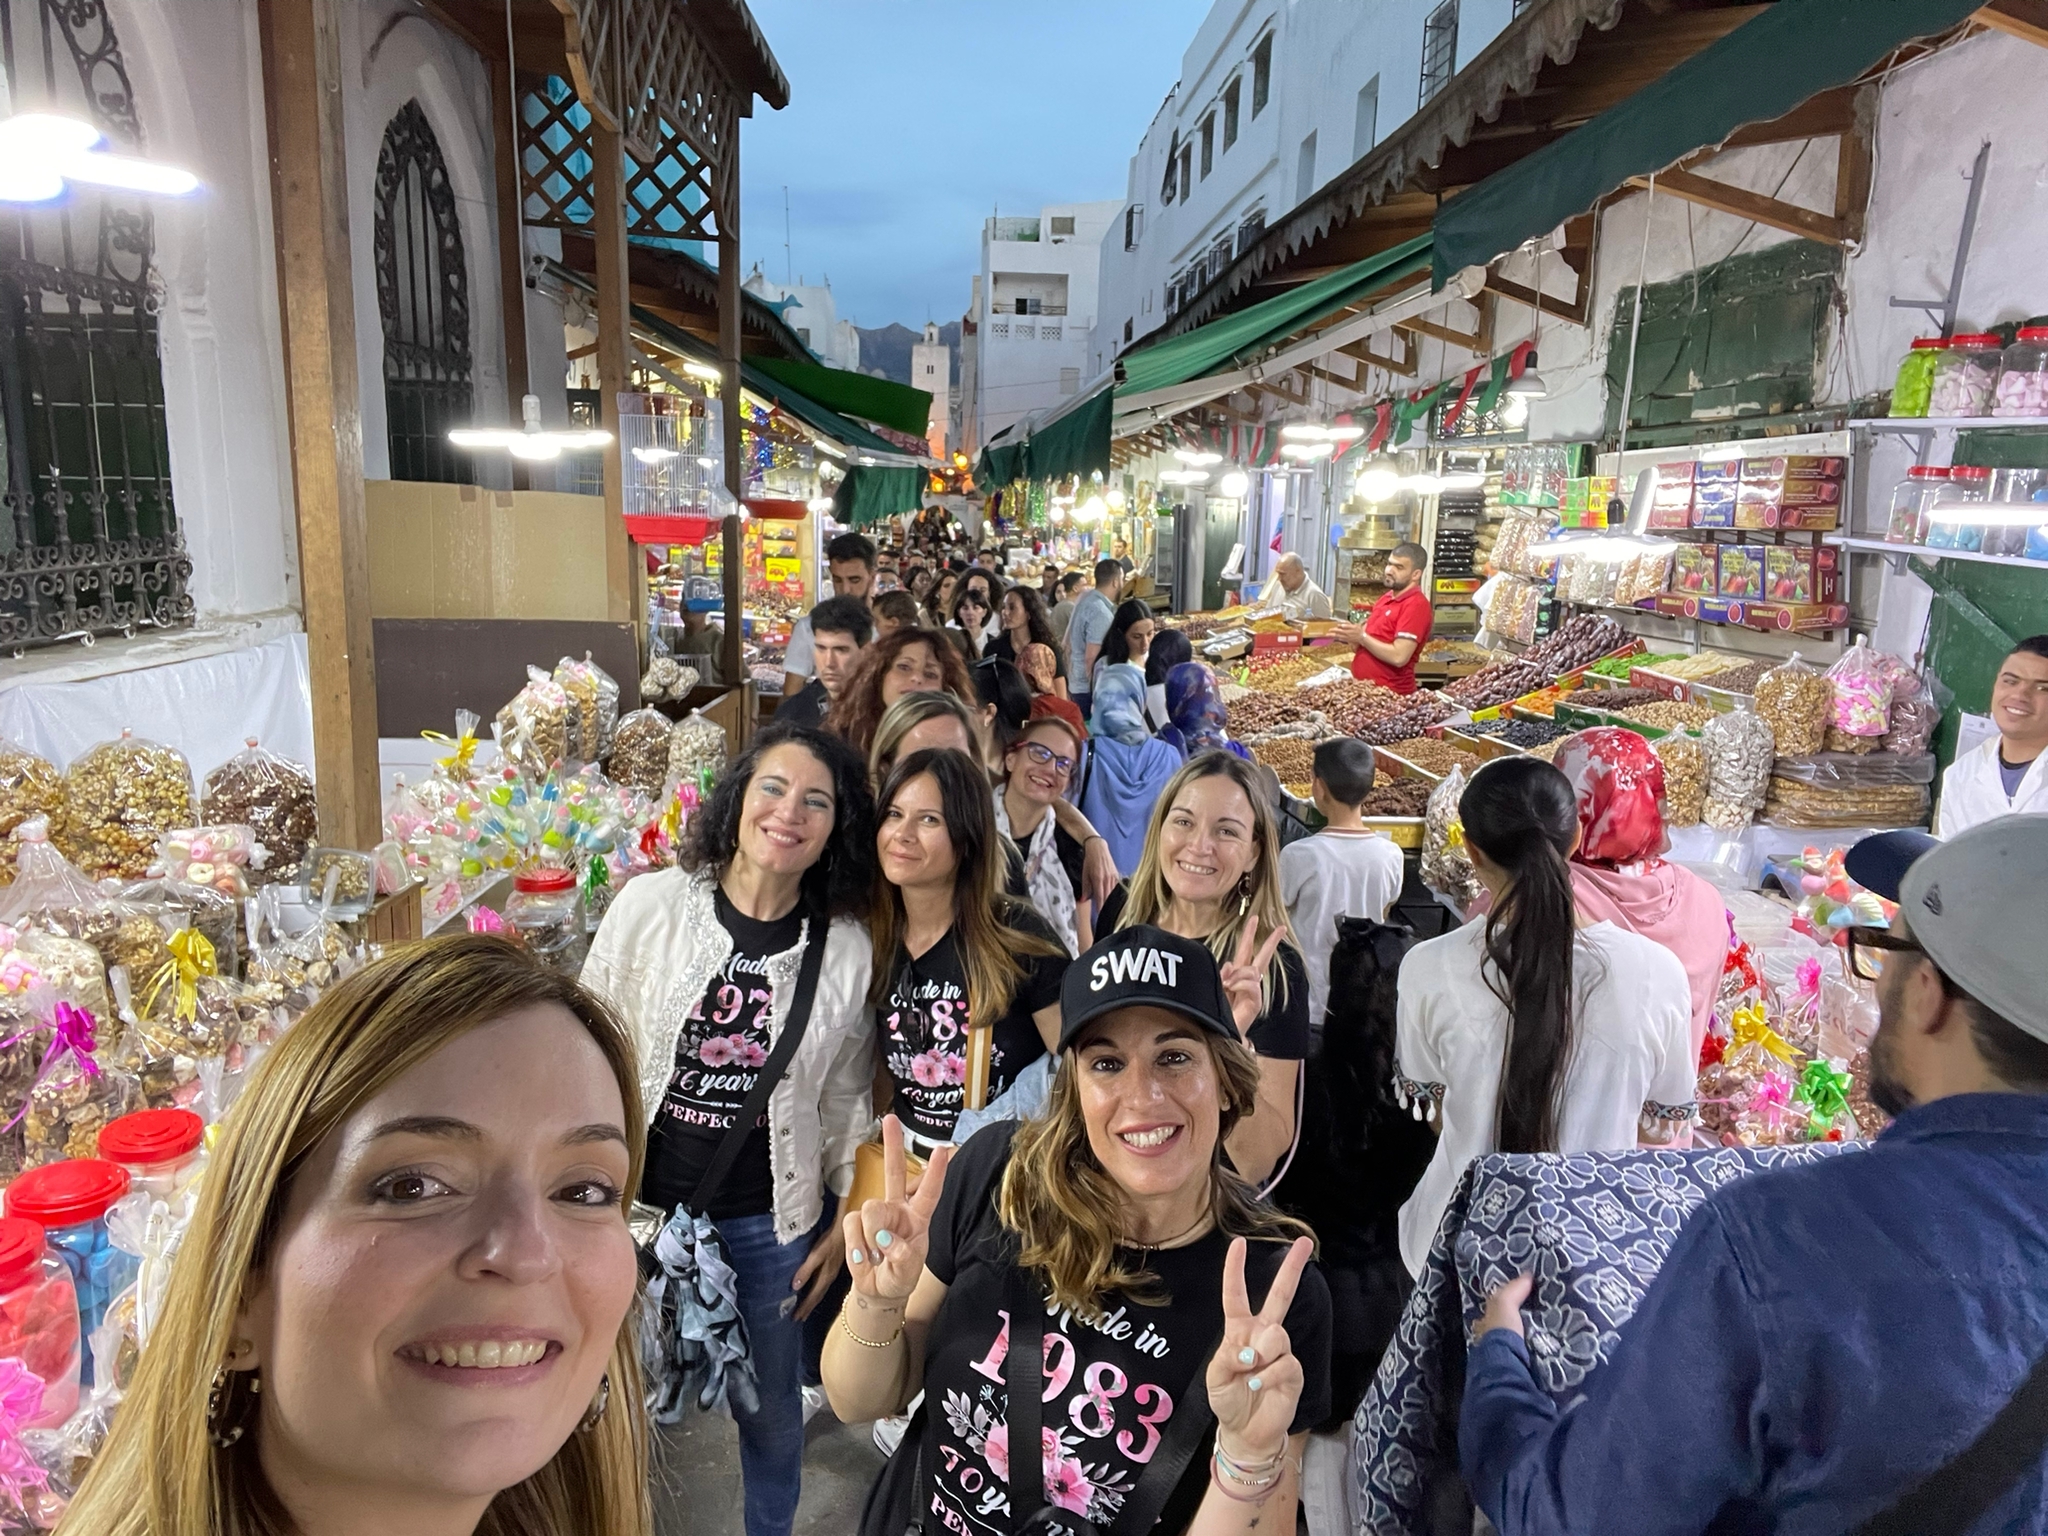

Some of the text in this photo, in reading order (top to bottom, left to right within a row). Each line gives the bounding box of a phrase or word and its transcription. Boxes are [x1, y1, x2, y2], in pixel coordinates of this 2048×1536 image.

[942, 981, 962, 999] in
[1090, 947, 1183, 992] SWAT
[690, 984, 774, 1029] 197
[1134, 1323, 1170, 1359] in
[969, 1309, 1173, 1464] 1983
